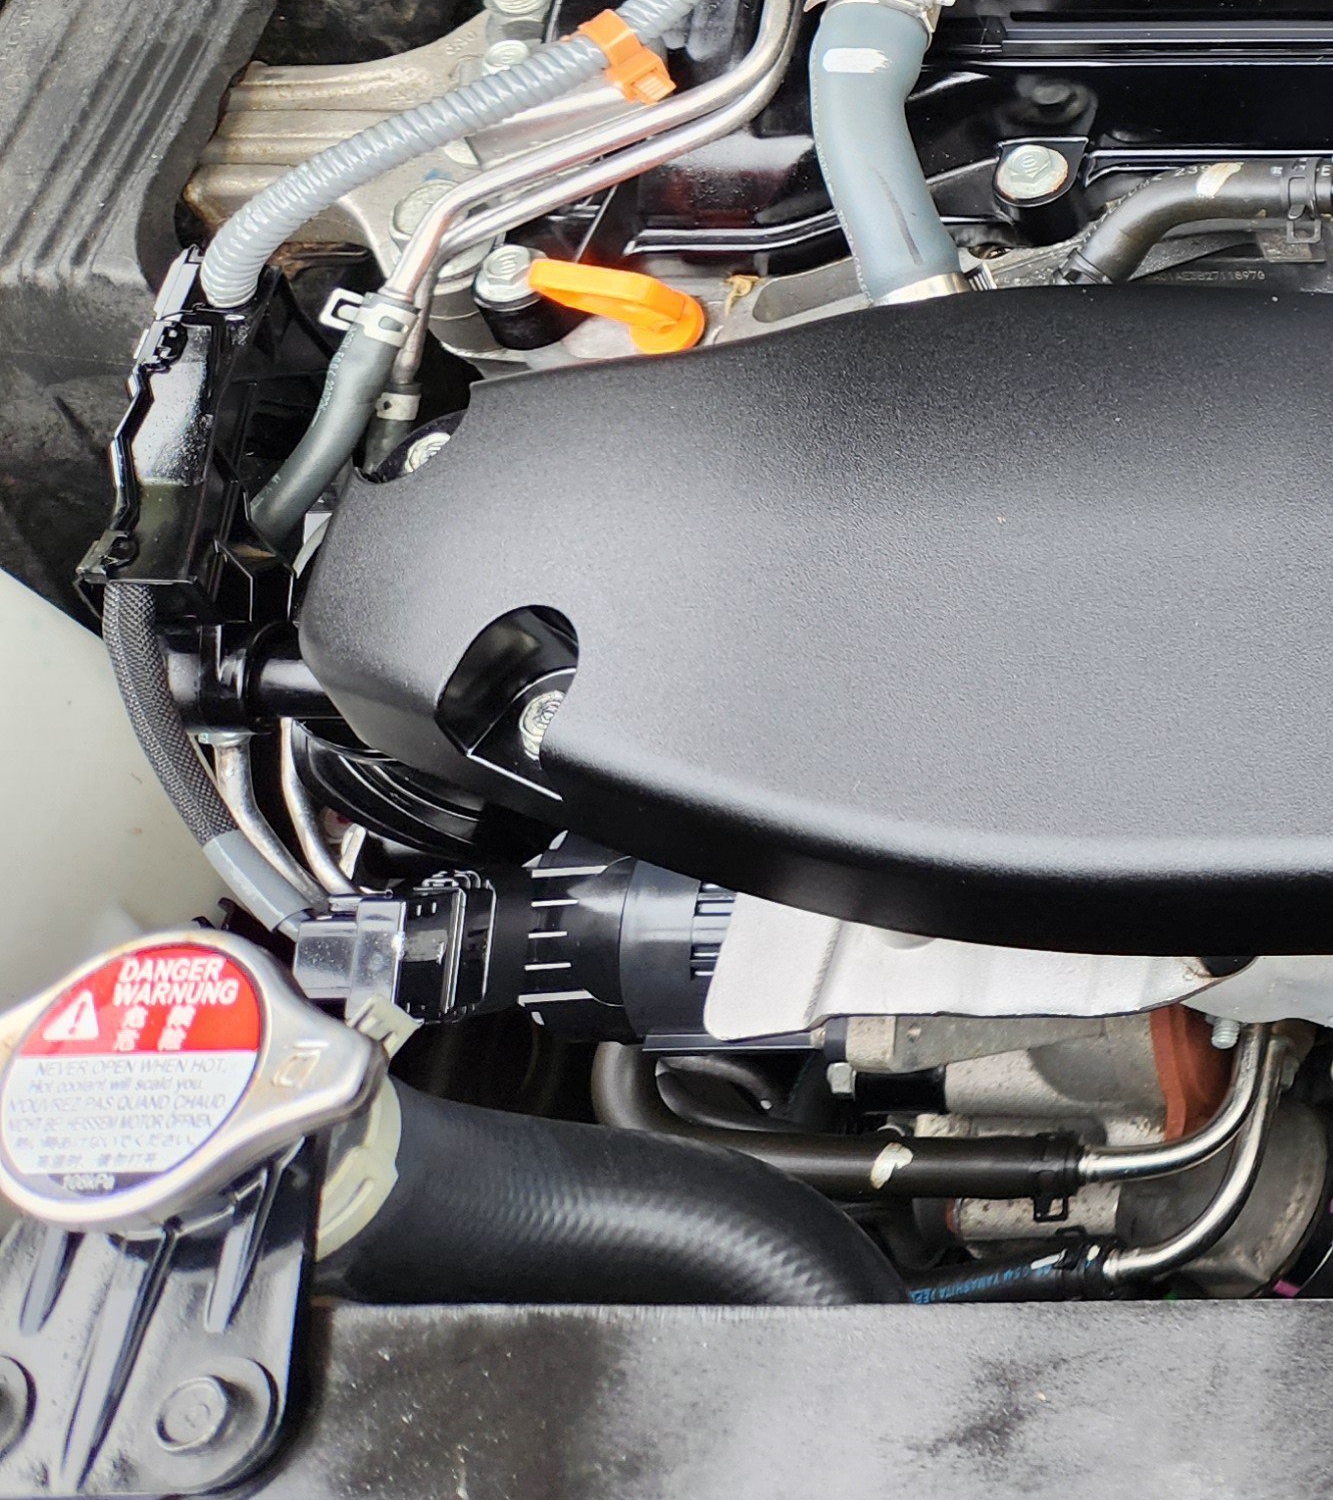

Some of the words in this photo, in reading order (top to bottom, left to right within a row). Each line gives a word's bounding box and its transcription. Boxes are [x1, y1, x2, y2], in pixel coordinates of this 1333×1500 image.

[119, 957, 226, 982] DANGER
[112, 979, 239, 1006] WARNUNG
[35, 1061, 88, 1076] NEVER
[92, 1060, 135, 1075] OPEN
[141, 1059, 187, 1074] WHEN
[110, 1078, 131, 1091] will
[117, 1095, 170, 1111] QUAND
